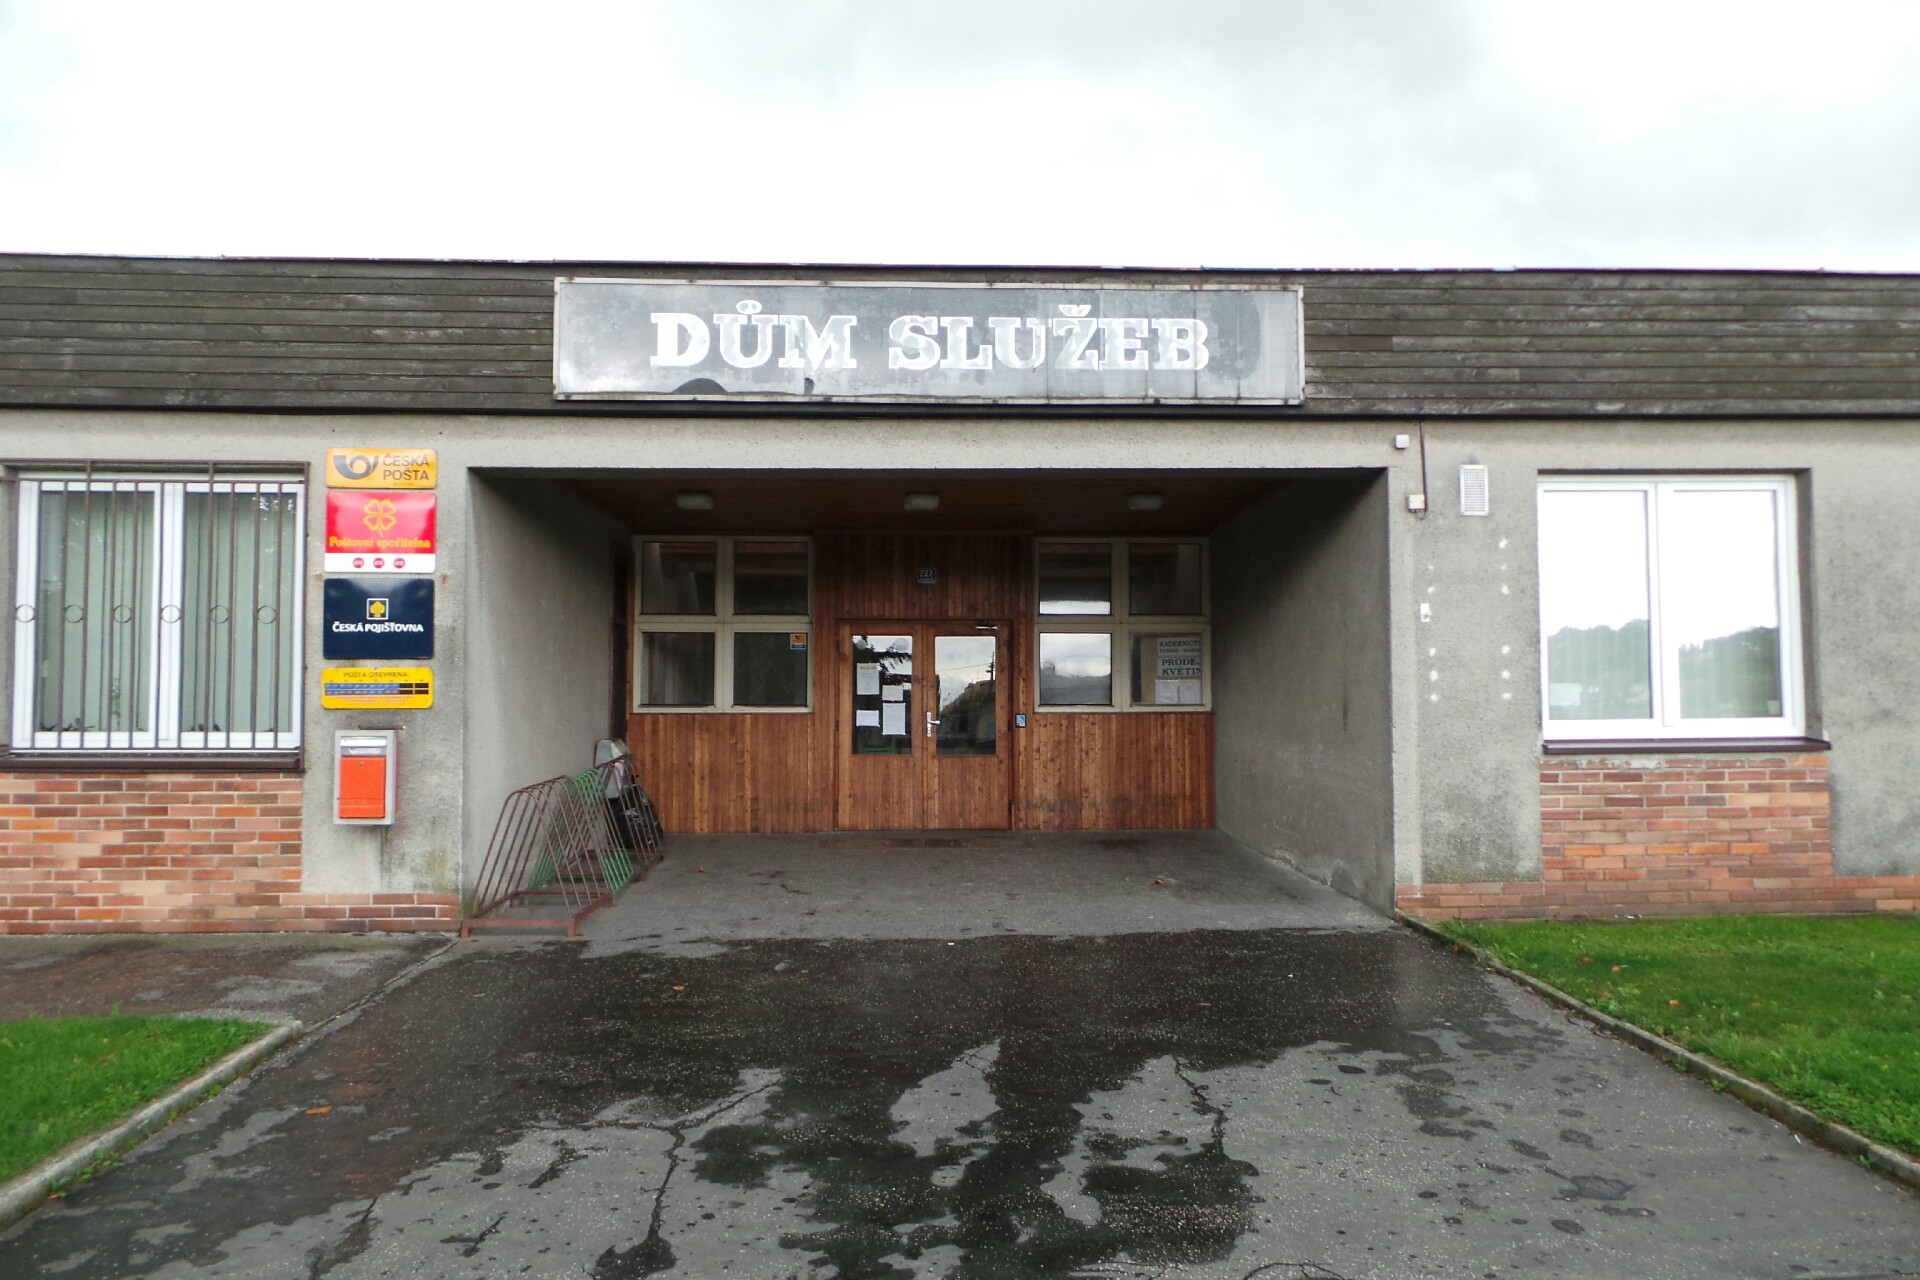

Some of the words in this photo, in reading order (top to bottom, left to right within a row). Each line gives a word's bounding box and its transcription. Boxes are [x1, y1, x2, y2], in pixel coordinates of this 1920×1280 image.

[649, 299, 858, 370] DŮM
[888, 303, 1211, 372] SLUŽEB
[382, 453, 430, 467] ČESKÁ
[382, 468, 429, 481] POŠTA
[332, 621, 364, 632] ČESKÁ
[364, 622, 424, 634] POJIŠŤOVNA
